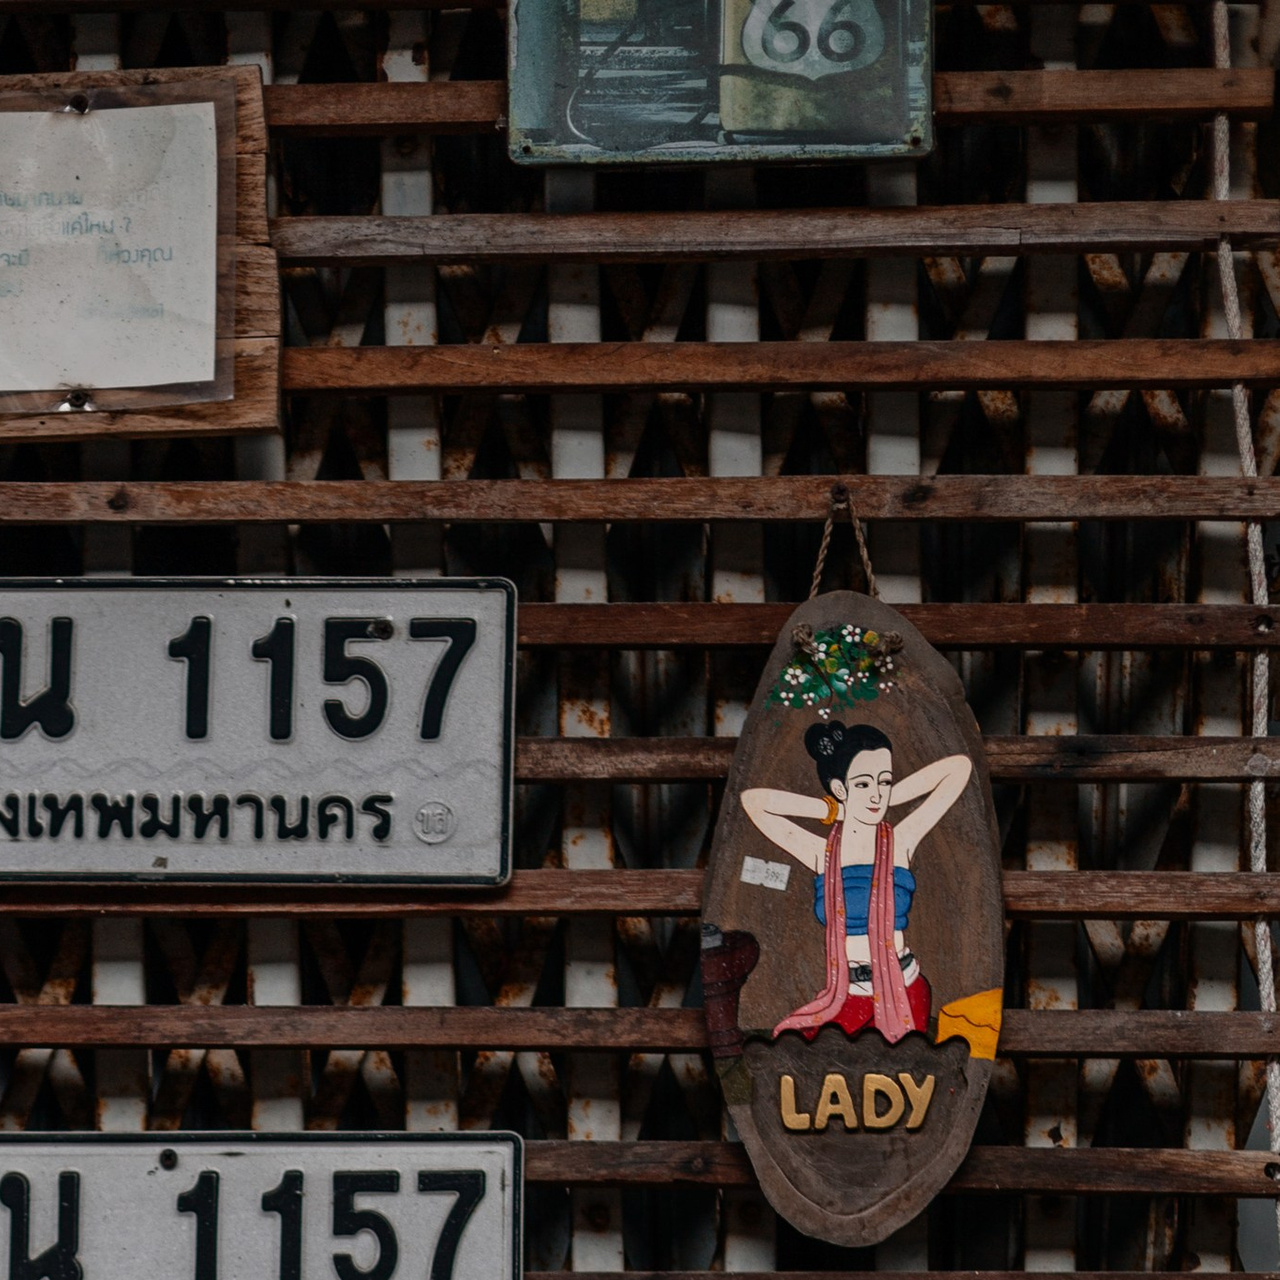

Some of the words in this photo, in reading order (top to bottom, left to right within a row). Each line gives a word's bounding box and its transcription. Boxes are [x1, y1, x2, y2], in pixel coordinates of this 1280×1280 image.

[761, 0, 866, 62] 66
[167, 616, 478, 740] 1157
[778, 1070, 937, 1134] LADY
